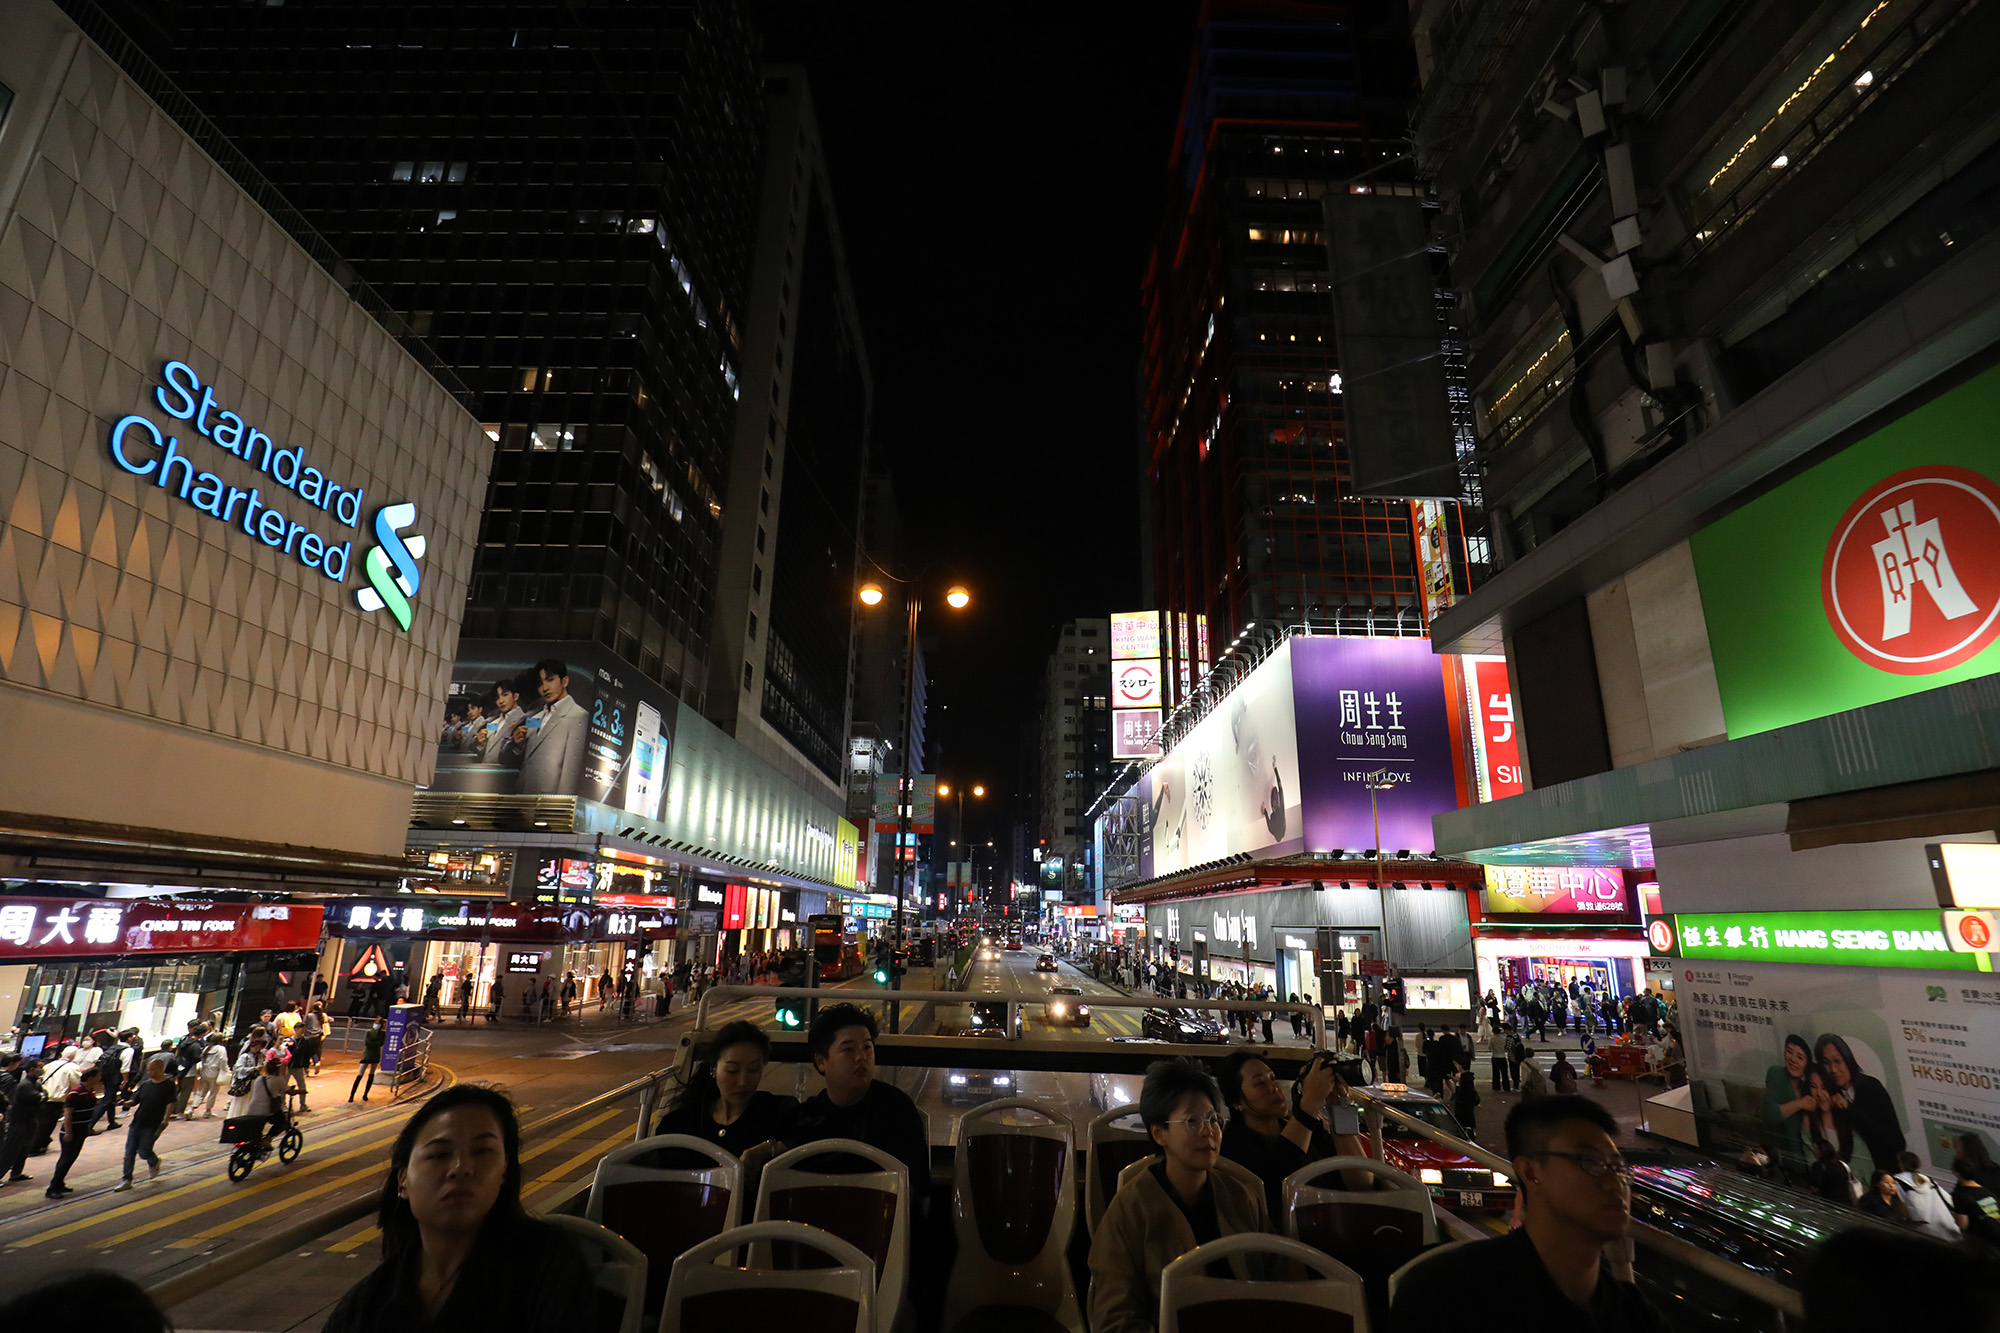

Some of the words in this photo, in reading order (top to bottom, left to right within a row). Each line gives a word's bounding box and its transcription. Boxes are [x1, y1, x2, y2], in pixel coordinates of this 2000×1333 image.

[156, 360, 364, 528] Standard
[111, 415, 351, 582] Chartered
[1115, 635, 1136, 643] KING
[1121, 643, 1150, 651] CENTRE
[1119, 679, 1156, 688] スシロー
[592, 699, 607, 728] 2%
[610, 708, 625, 737] 3%
[1339, 690, 1406, 730] 周生生
[1123, 720, 1153, 738] 周生生
[1341, 731, 1364, 746] Chow
[1366, 731, 1386, 748] Sang
[1386, 732, 1407, 748] Sang
[1383, 771, 1411, 783] LOVE
[1495, 867, 1620, 900] 瓊華中心
[0, 905, 123, 945] 周大福
[140, 920, 179, 932] CHOW
[181, 920, 202, 931] TAI
[203, 920, 235, 931] FOOK
[348, 906, 424, 931] 周大福
[438, 916, 467, 925] CHOW
[469, 917, 486, 926] TAI
[1682, 925, 1769, 948] 恒生銀行
[1774, 929, 1828, 950] HANG
[1831, 929, 1890, 950] SENG
[1892, 930, 1949, 951] BAN
[1692, 992, 1790, 1013] 為家人策劃現在與未來
[1903, 1026, 1927, 1043] 5%
[1911, 1064, 1992, 1090] HK$6,000
